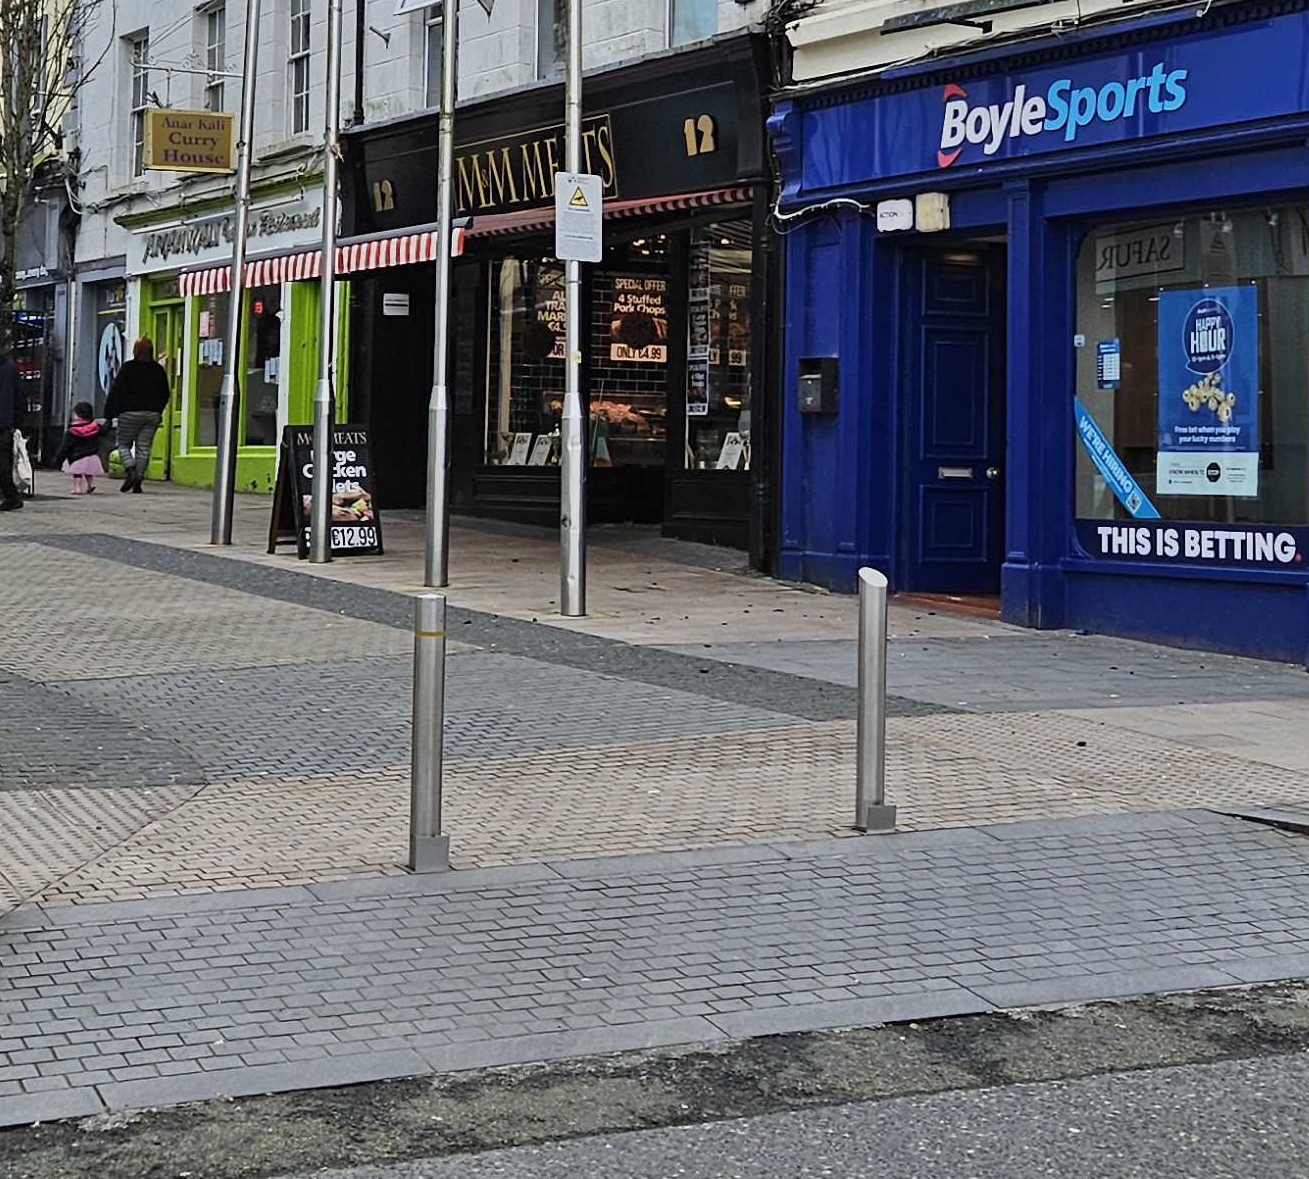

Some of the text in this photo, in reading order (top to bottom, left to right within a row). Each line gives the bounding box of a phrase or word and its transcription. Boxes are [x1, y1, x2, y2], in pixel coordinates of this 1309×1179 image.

[939, 62, 1188, 155] BoyleSports
[162, 117, 225, 131] Anar Kali
[169, 132, 218, 150] Curry
[683, 114, 716, 156] 12
[163, 149, 224, 164] House
[520, 126, 614, 204] METS
[373, 179, 394, 212] 12
[645, 280, 666, 291] OFFER
[614, 302, 666, 316] Pork Chops
[618, 294, 661, 305] 4 Stuffed
[1196, 316, 1221, 331] HAPPY
[1191, 328, 1226, 354] HOUR
[1079, 416, 1105, 456] WE'RE
[1101, 449, 1133, 493] HIRING
[302, 463, 367, 478] Cken
[332, 527, 376, 547] €12.99
[1097, 526, 1151, 556] THIS
[1156, 528, 1179, 557] IS
